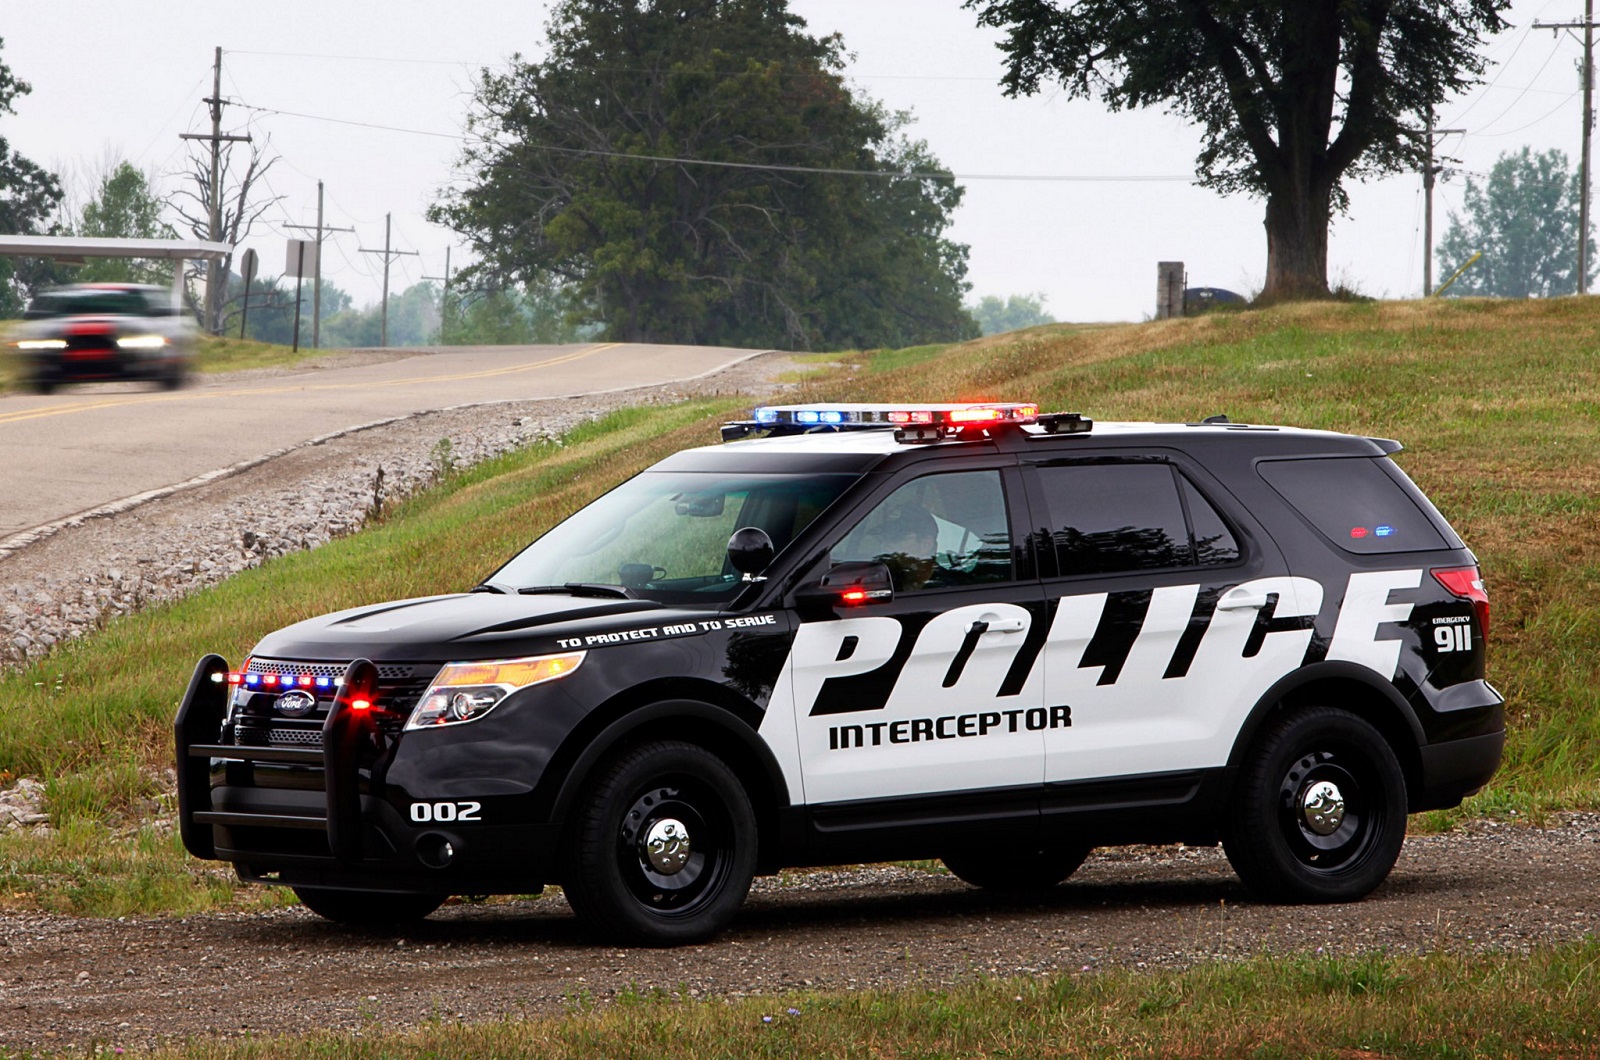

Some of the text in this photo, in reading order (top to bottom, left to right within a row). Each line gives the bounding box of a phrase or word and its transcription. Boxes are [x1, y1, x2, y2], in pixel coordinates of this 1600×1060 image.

[557, 615, 776, 648] TO PROTECT AND TO SERVE
[1432, 616, 1470, 625] EMERGENCY
[760, 569, 1423, 720] POLICE
[1434, 624, 1471, 653] 911
[281, 693, 304, 709] Ford
[829, 705, 1072, 750] INTERCEPTOR
[410, 801, 482, 822] 002
